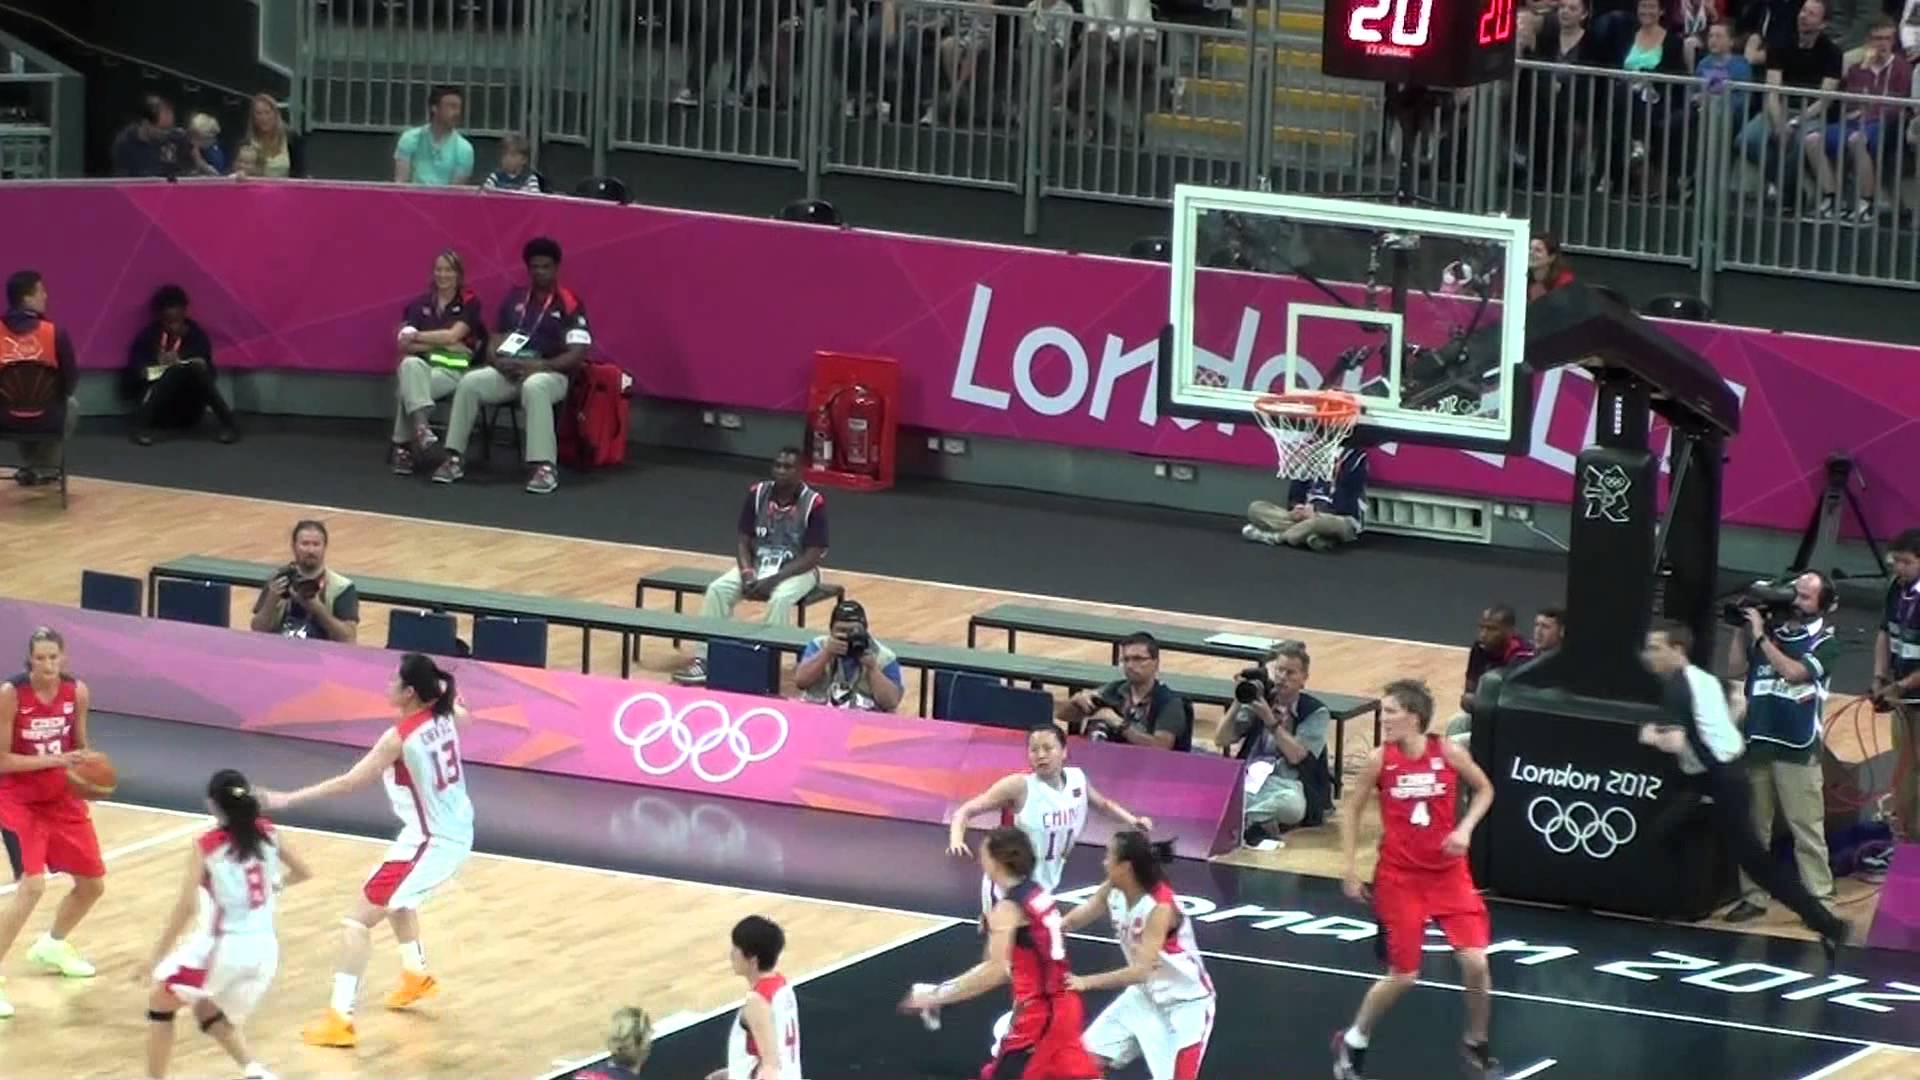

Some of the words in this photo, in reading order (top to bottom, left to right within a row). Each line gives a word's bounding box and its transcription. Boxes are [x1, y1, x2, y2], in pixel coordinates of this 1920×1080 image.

[1348, 0, 1433, 46] 20
[430, 740, 460, 792] 13
[1510, 756, 1600, 792] London
[1605, 770, 1663, 800] 2012
[1042, 807, 1079, 829] CHIN
[1409, 800, 1432, 827] 4
[1593, 950, 1920, 1013] 2012
